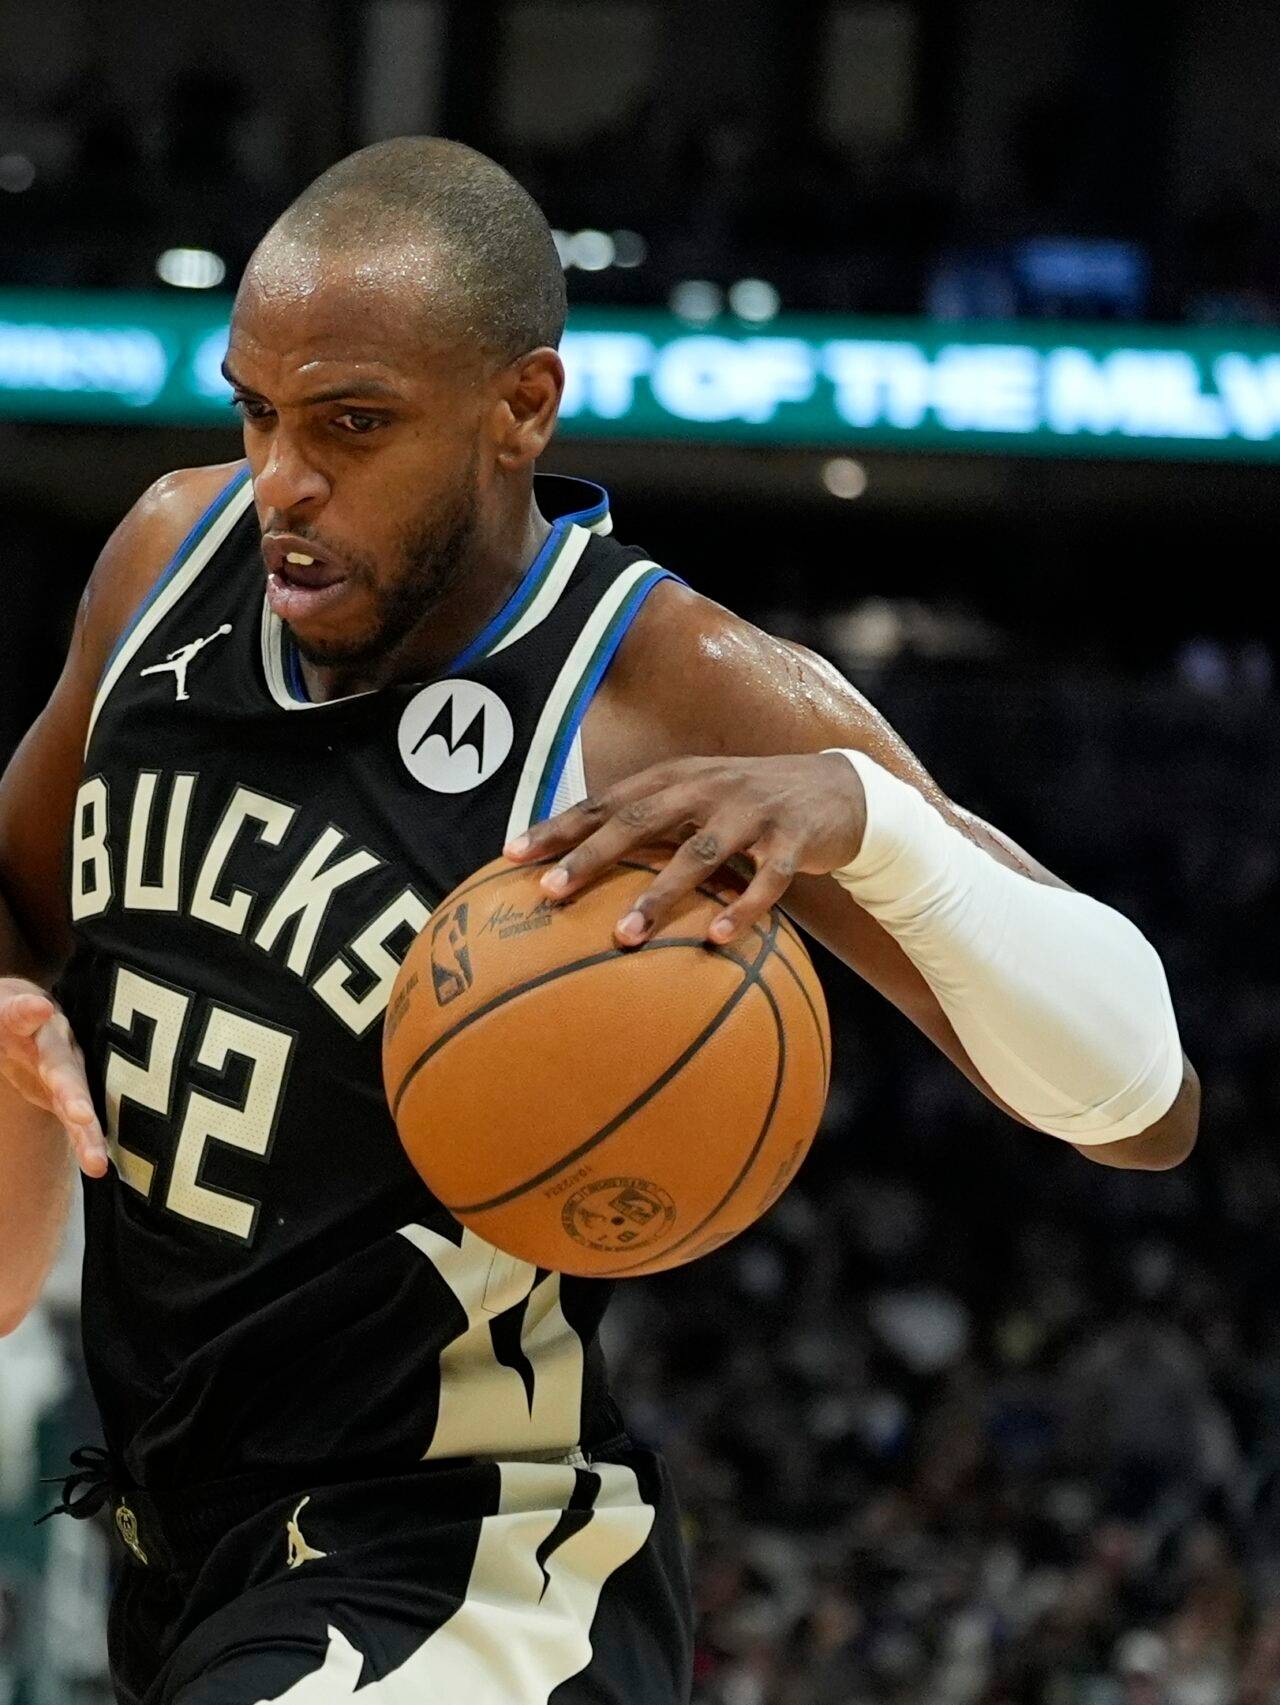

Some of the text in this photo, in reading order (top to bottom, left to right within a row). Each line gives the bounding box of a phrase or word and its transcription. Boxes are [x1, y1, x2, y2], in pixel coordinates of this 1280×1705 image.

[653, 336, 815, 424] OF
[825, 340, 1040, 432] THE
[72, 769, 434, 1037] BUCKS
[106, 966, 298, 1244] 22
